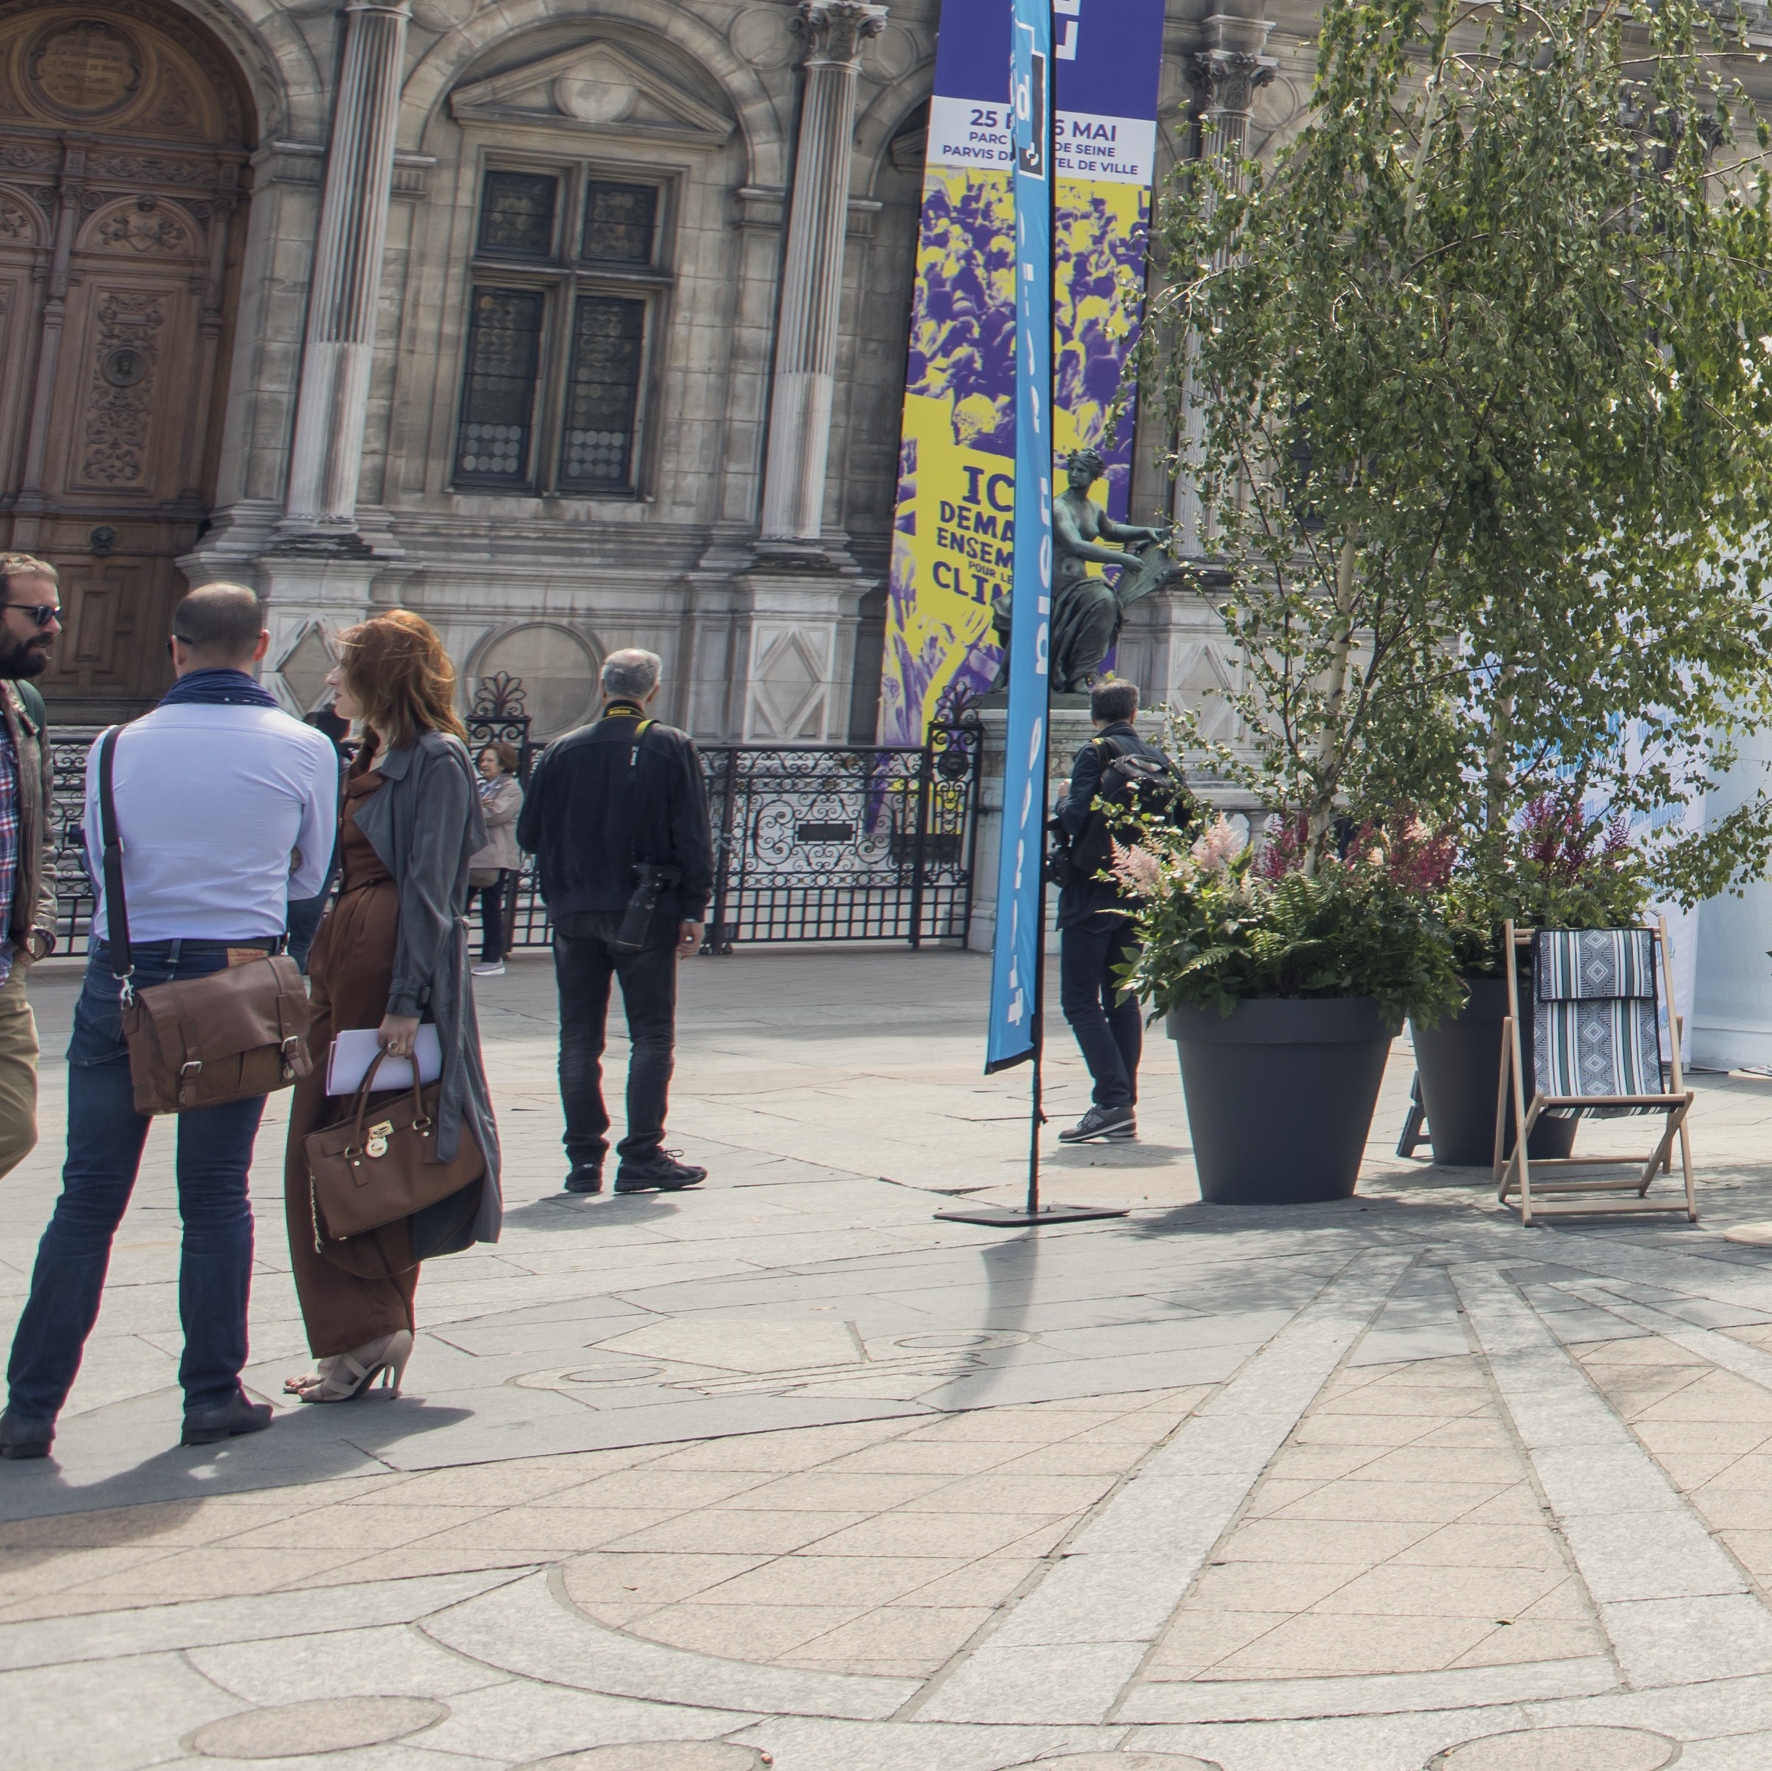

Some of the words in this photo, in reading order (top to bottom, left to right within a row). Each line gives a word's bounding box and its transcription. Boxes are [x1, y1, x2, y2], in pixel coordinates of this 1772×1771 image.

[970, 109, 998, 128] 25
[1073, 120, 1117, 142] MAI
[969, 131, 1008, 145] PARC
[1075, 143, 1116, 157] SEINE
[943, 145, 994, 159] PARVIS
[998, 150, 1013, 162] D
[1078, 159, 1096, 171] DE
[1100, 161, 1138, 175] VILLE
[969, 560, 996, 578] POUR
